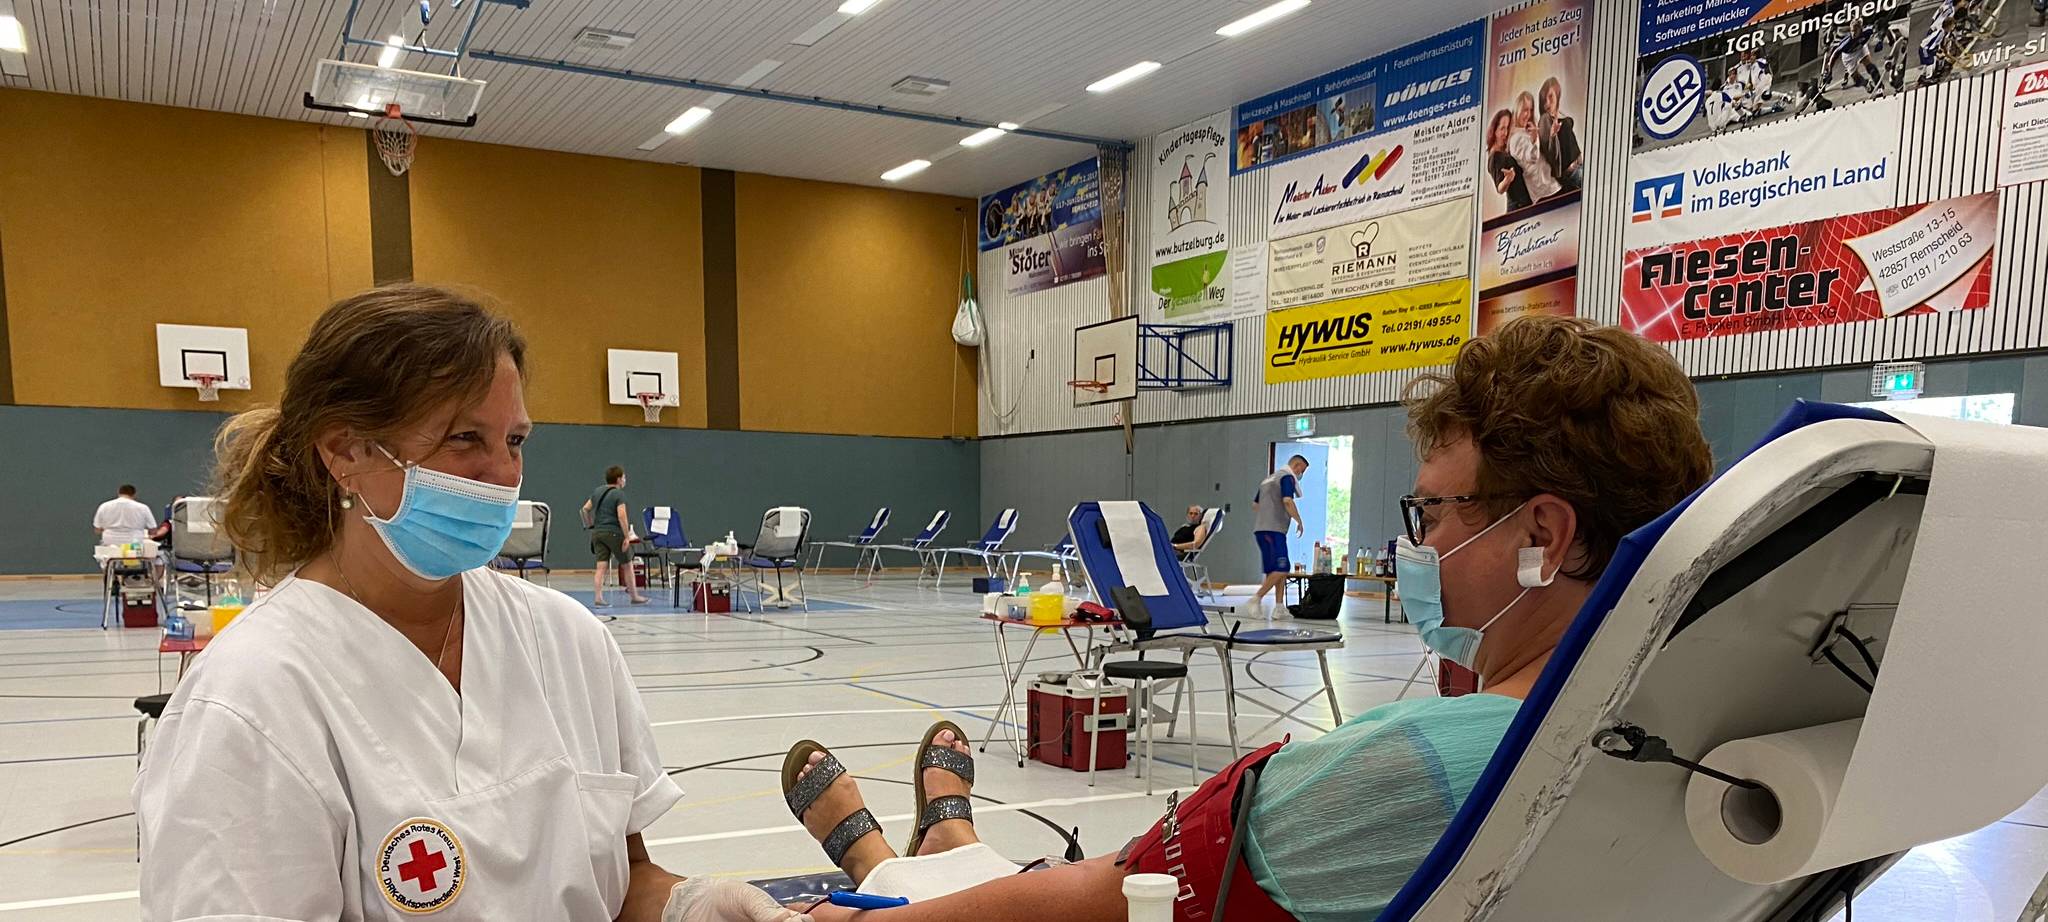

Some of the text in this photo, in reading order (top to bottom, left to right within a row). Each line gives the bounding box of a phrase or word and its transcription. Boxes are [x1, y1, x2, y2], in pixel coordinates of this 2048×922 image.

[1500, 8, 1582, 44] Jeder hat das Zeug
[1655, 7, 1750, 42] Software Entwickler
[1656, 4, 1704, 25] Marketing
[1726, 0, 1898, 56] IGR Remscheid
[1393, 36, 1474, 70] Feuerwehrausrüstung
[1499, 24, 1580, 67] zum Sieger!
[1973, 32, 2048, 67] wir si
[1383, 67, 1473, 108] DÖNGES
[1383, 94, 1472, 128] www.doenges-rs.de
[1413, 115, 1476, 139] Meister Alders
[2012, 120, 2030, 130] Karl
[1158, 126, 1225, 166] Kindertagespflege
[1691, 158, 1887, 213] im Bergischen Land
[1692, 150, 1791, 187] Volksbank
[1302, 207, 1313, 218] und
[1373, 184, 1405, 201] Remscheid
[1087, 245, 1098, 258] ins
[1155, 232, 1225, 258] www.butzelburg.de
[1358, 244, 1370, 257] R
[1872, 207, 1956, 262] Weststraße 13-15
[1879, 221, 1964, 280] 42857 Remscheid
[1012, 246, 1052, 275] Stöter
[1332, 254, 1397, 276] RIEMANN
[1901, 264, 1931, 290] 02191
[1938, 244, 1958, 265] 210
[1957, 232, 1973, 248] 63
[1158, 297, 1171, 310] Der
[1208, 286, 1225, 302] Weg
[1381, 323, 1396, 335] Tel.
[1681, 323, 1692, 335] E.
[1696, 314, 1741, 333] Franken
[1743, 308, 1782, 328] GmbH
[1818, 304, 1838, 320] KG
[1298, 348, 1371, 366] Hydraulik Service GmbH
[1380, 334, 1460, 355] www.hywus.de
[381, 824, 456, 872] Deutsches Rotes Kreuz
[383, 877, 460, 909] DRK-Blutspendedienst
